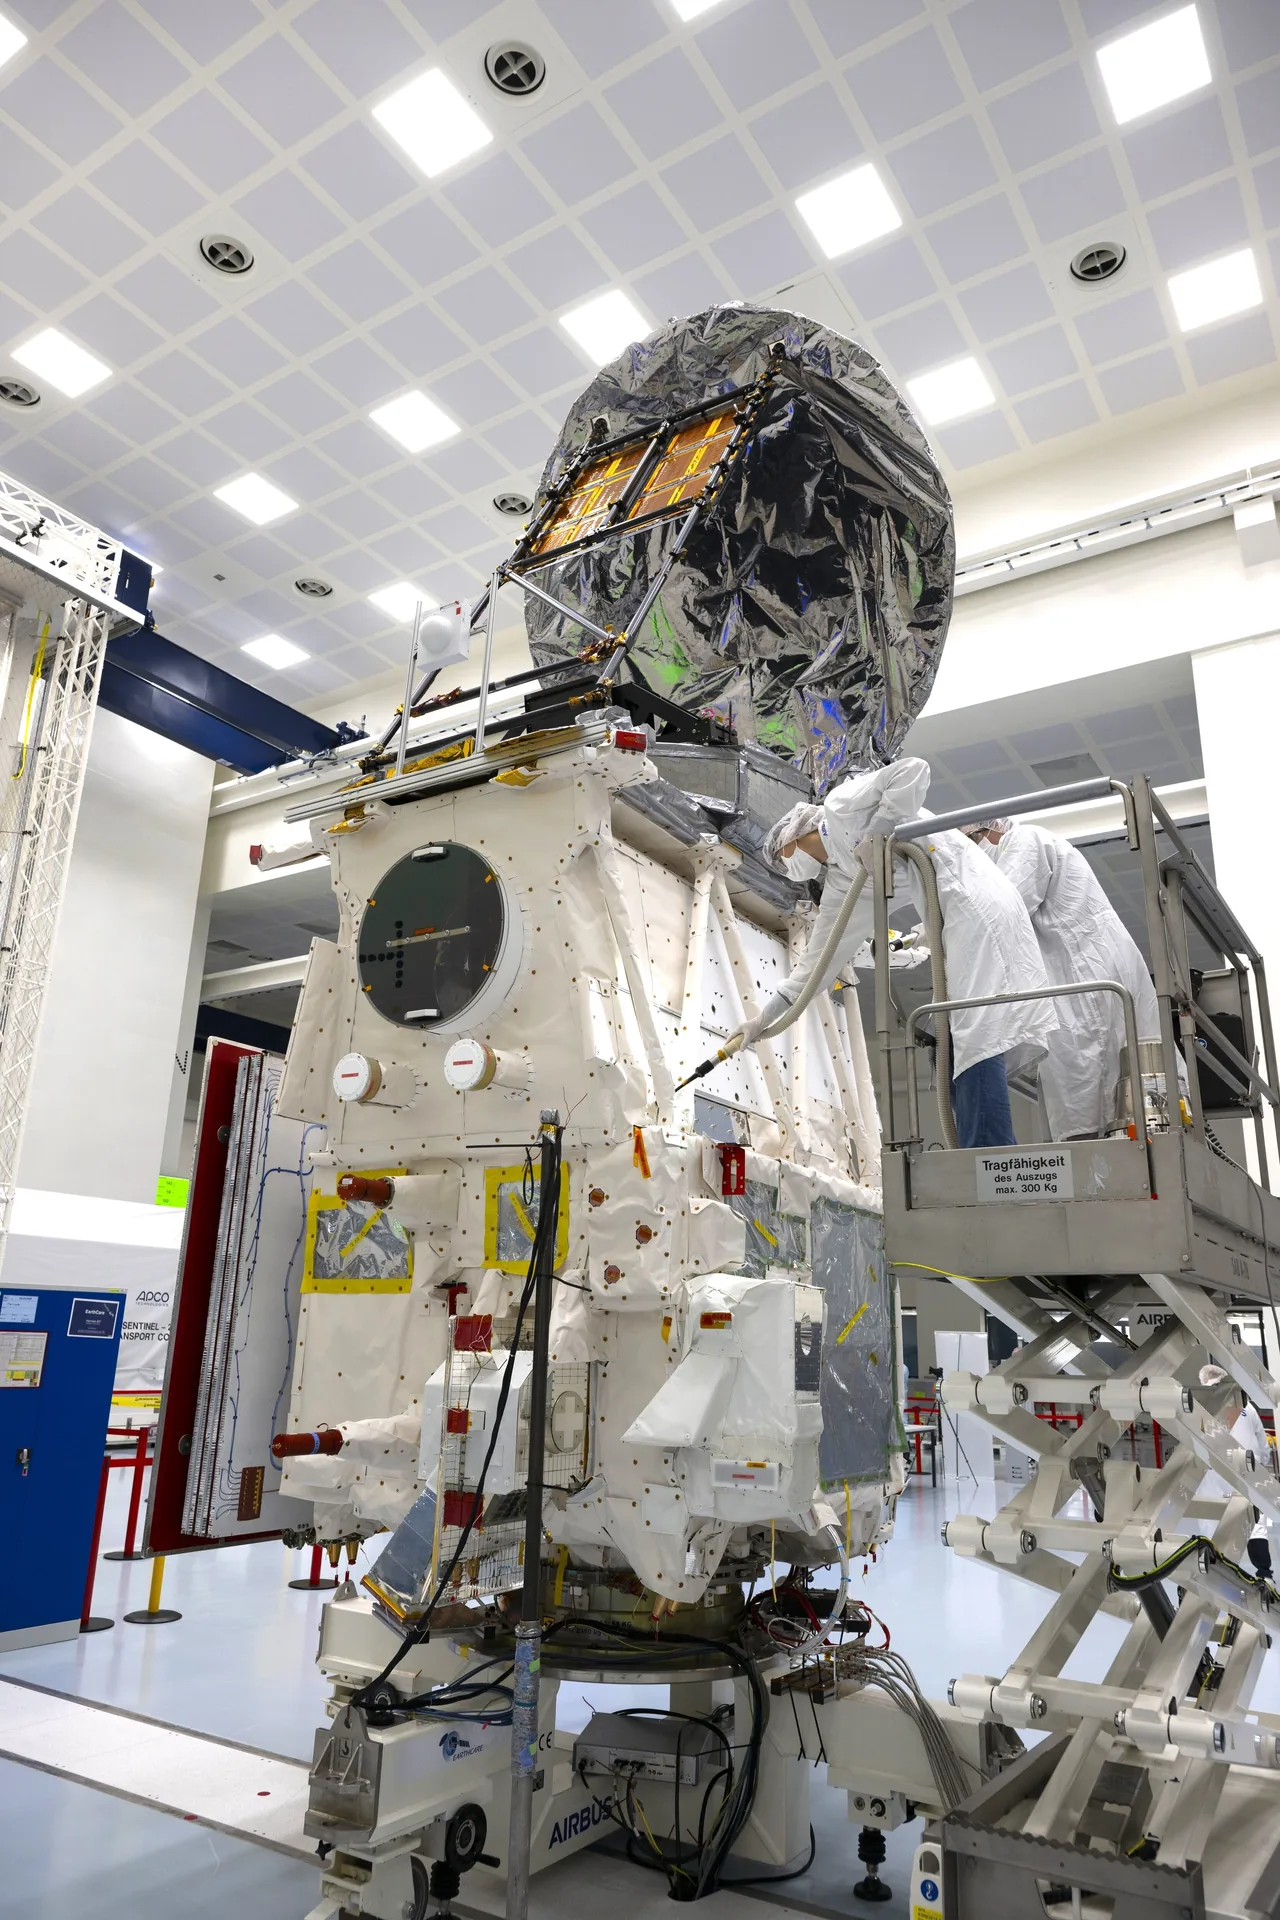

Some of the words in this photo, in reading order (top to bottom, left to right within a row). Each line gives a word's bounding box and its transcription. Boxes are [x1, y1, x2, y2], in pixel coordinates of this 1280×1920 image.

[982, 1156, 1065, 1172] Tragfähigkeit
[994, 1174, 1012, 1183] des
[1016, 1172, 1058, 1182] Auszugs
[996, 1186, 1018, 1194] max.
[1021, 1183, 1041, 1193] 300
[1044, 1183, 1058, 1193] Kg
[136, 1291, 170, 1303] APCO
[122, 1321, 160, 1331] SENTINEL
[452, 1744, 484, 1761] EARTHCARE
[548, 1796, 612, 1850] AIRBUS
